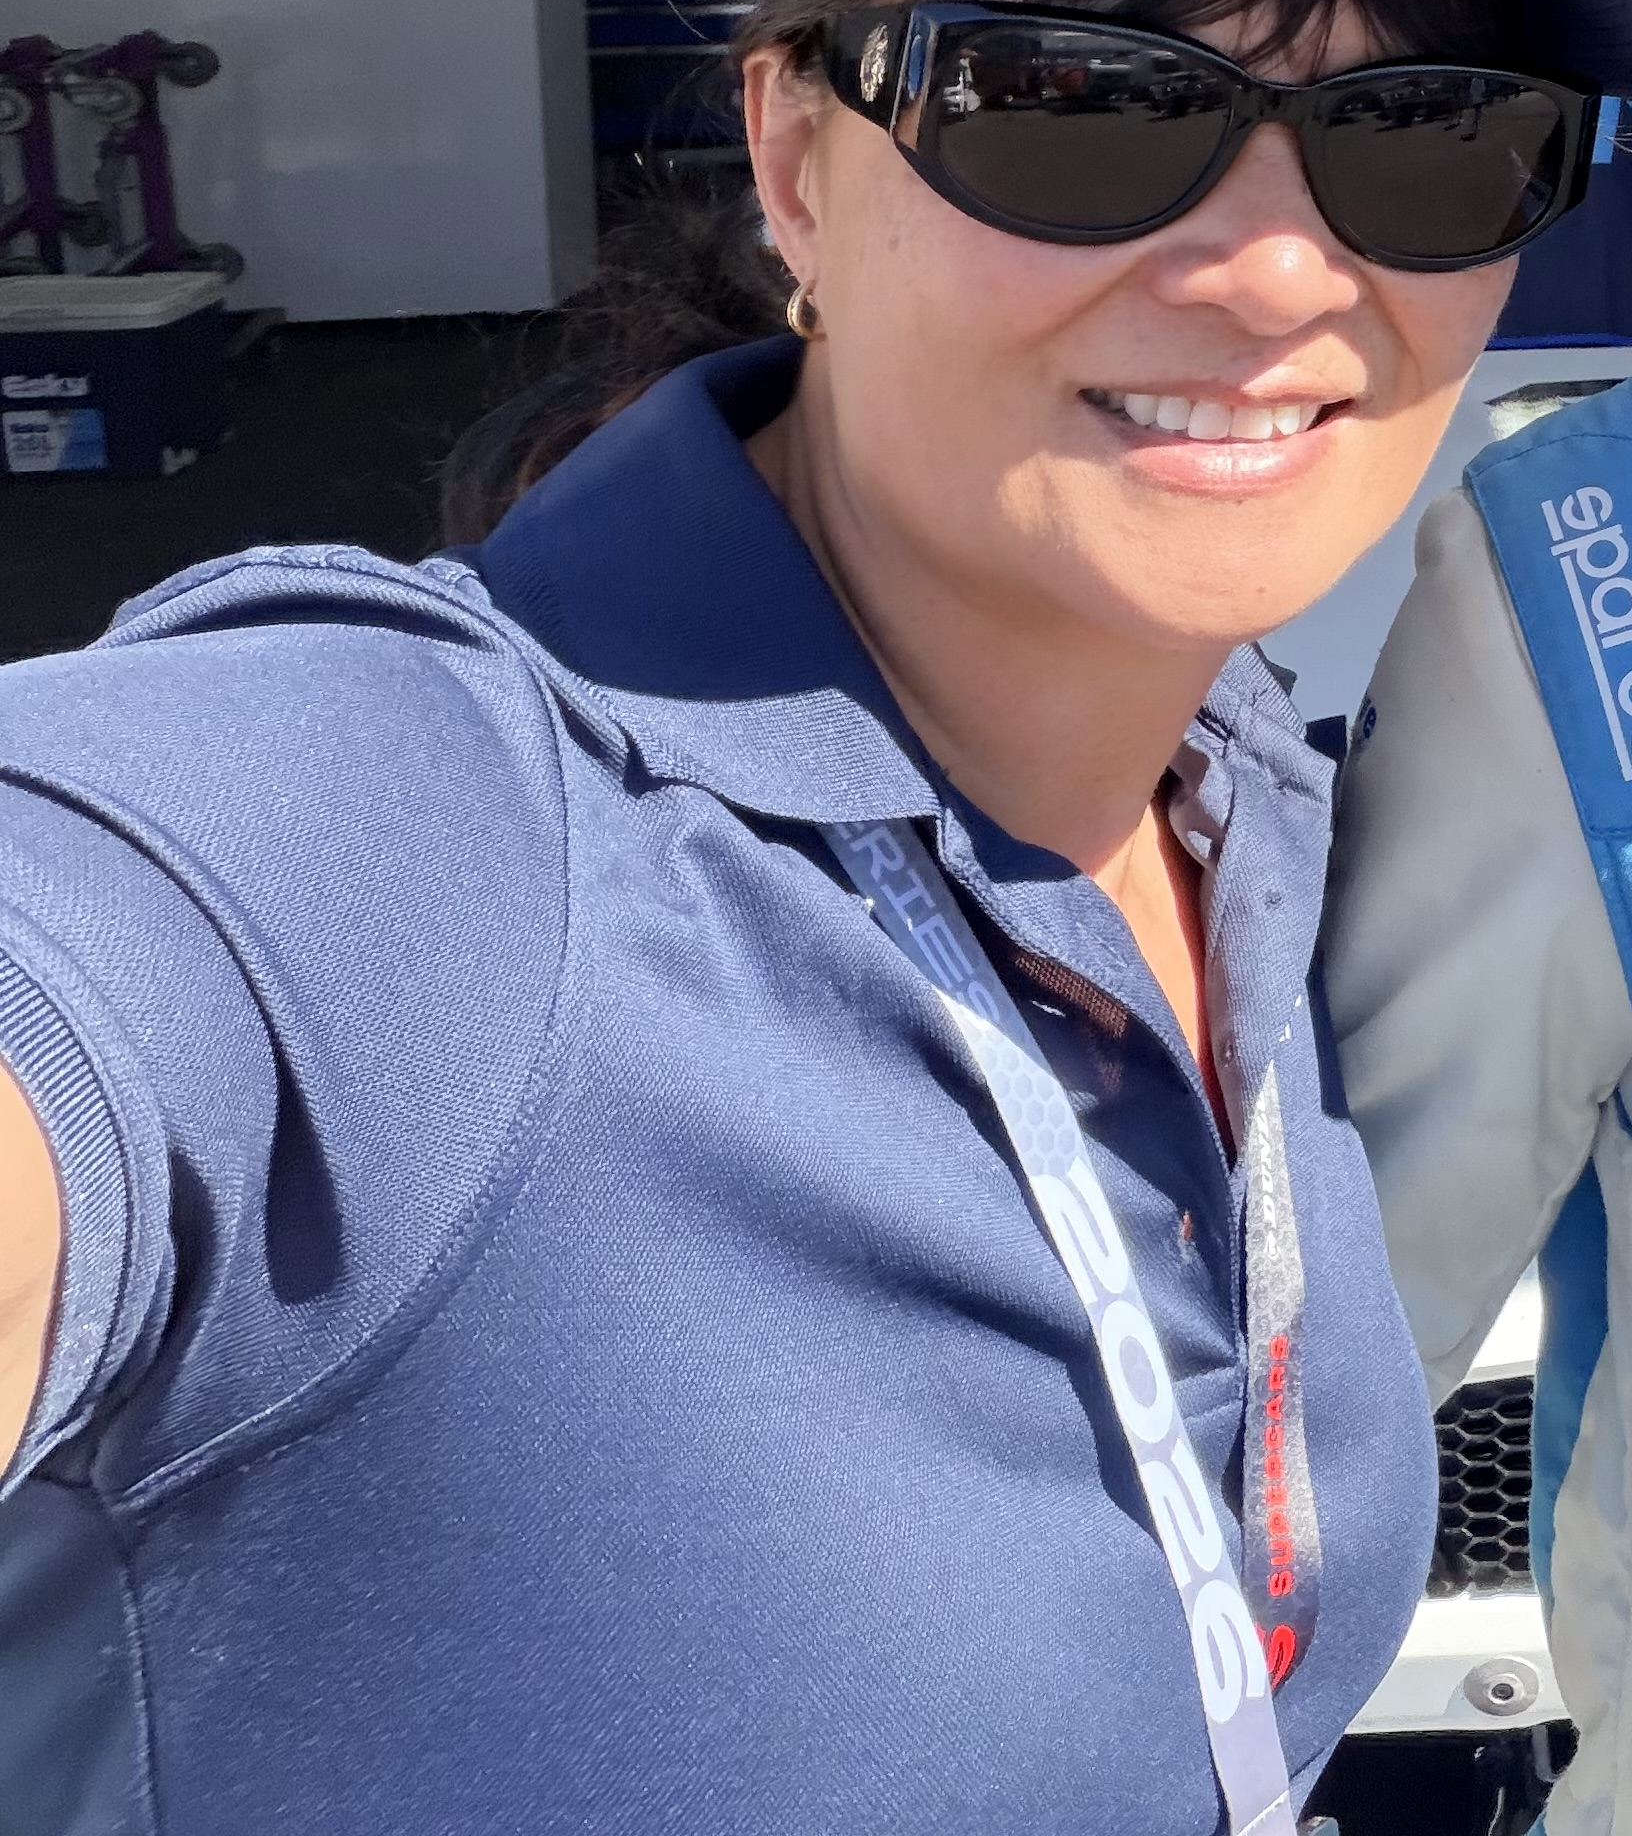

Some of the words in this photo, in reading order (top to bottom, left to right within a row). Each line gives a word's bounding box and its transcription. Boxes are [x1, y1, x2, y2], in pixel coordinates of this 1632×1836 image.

[836, 820, 998, 1026] RIES
[1030, 1156, 1268, 1725] 2026
[1267, 1335, 1291, 1598] SUPERCARS
